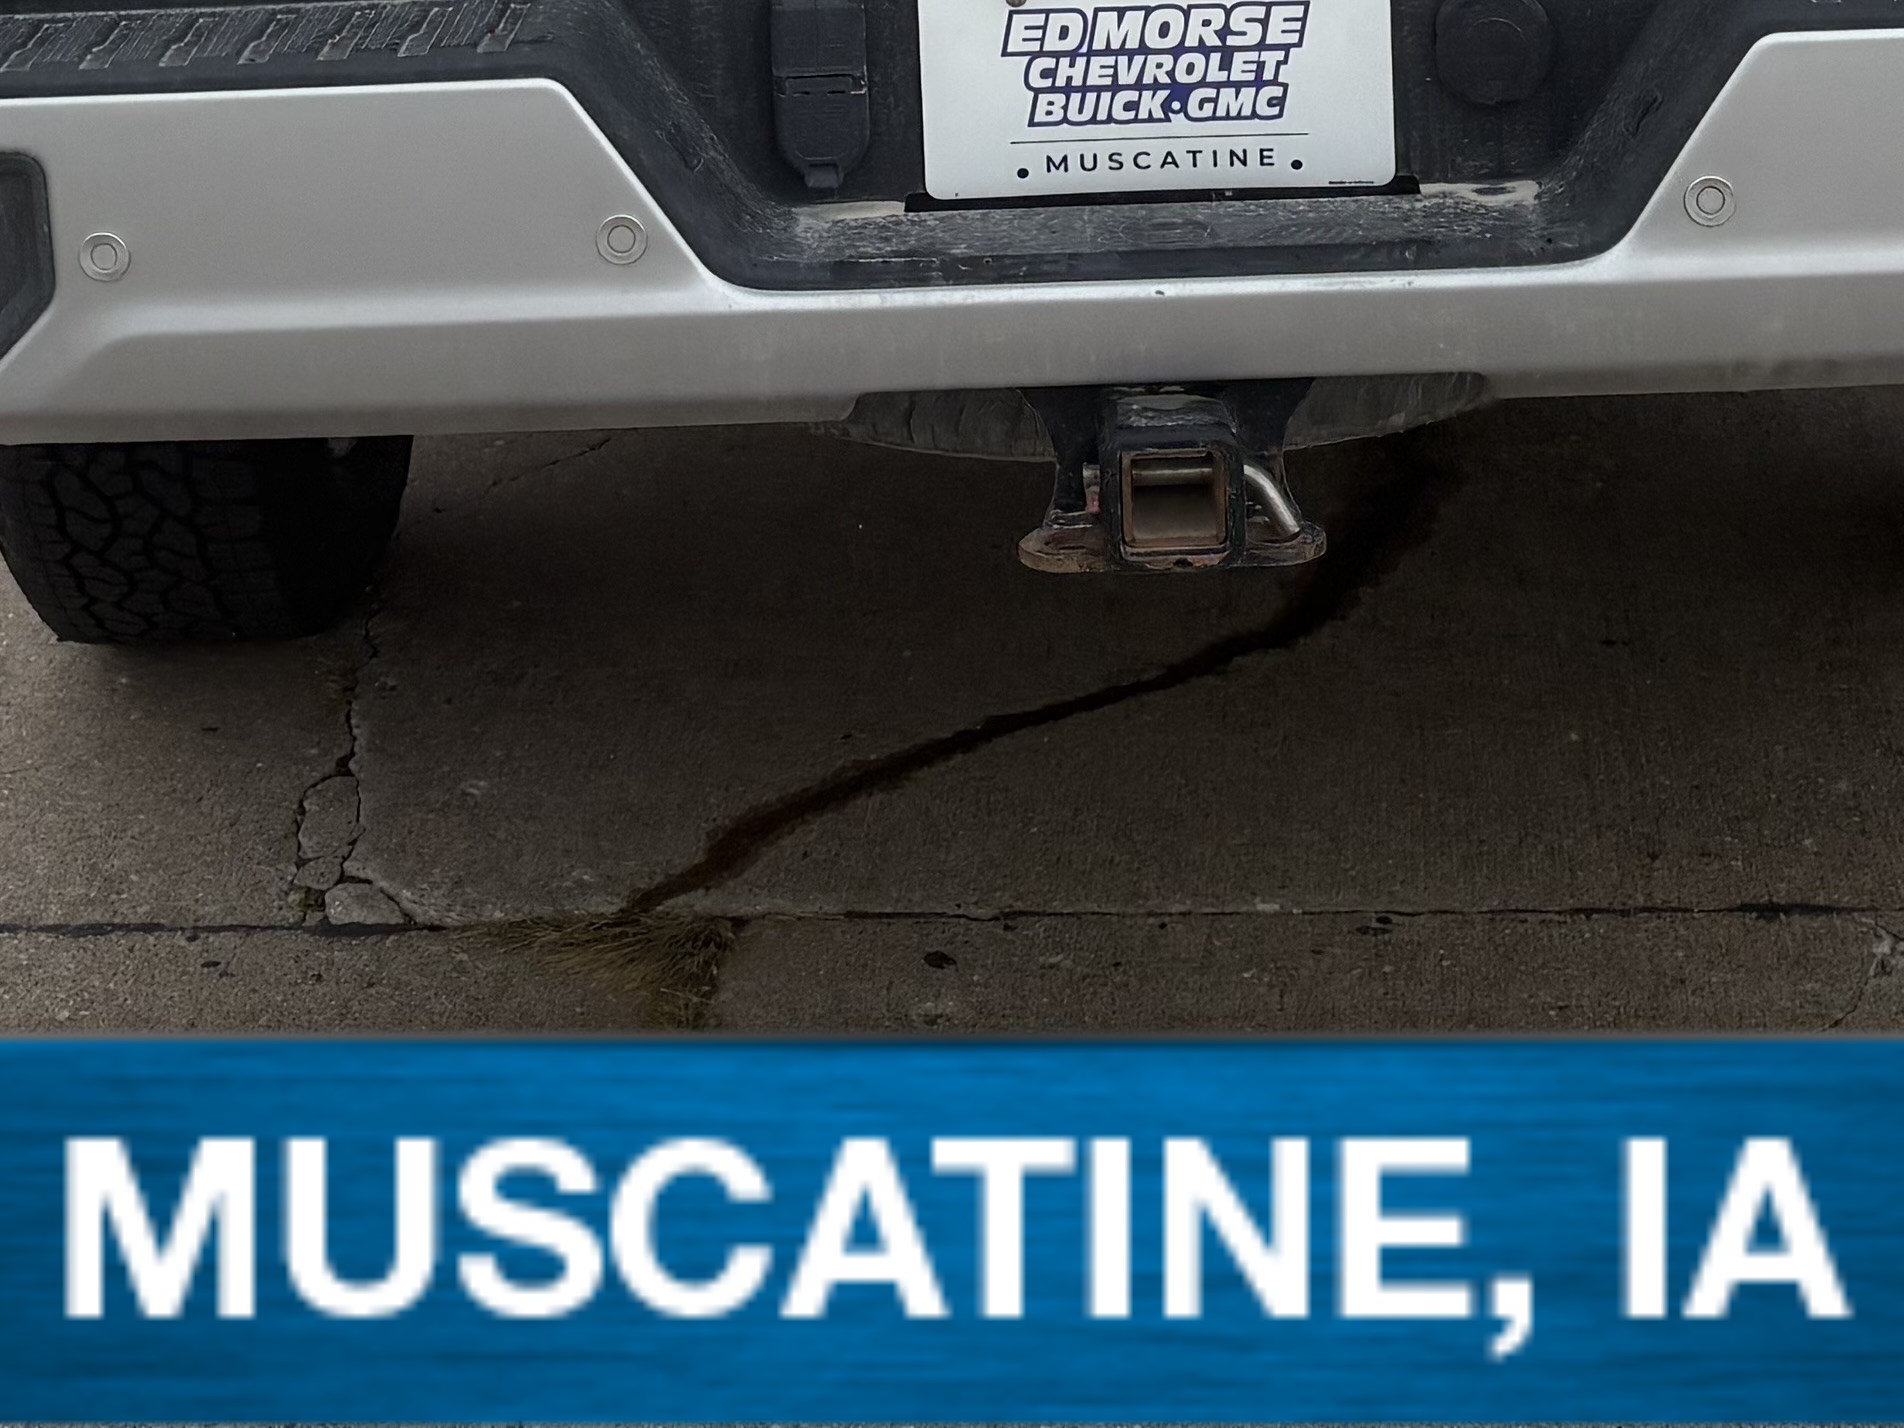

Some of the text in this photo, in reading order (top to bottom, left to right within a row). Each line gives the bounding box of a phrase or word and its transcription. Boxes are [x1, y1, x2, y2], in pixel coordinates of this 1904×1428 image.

[1003, 1, 1310, 56] ED MORSE
[1025, 50, 1287, 89] CHEVROLET
[1045, 147, 1276, 174] MUSCATINE
